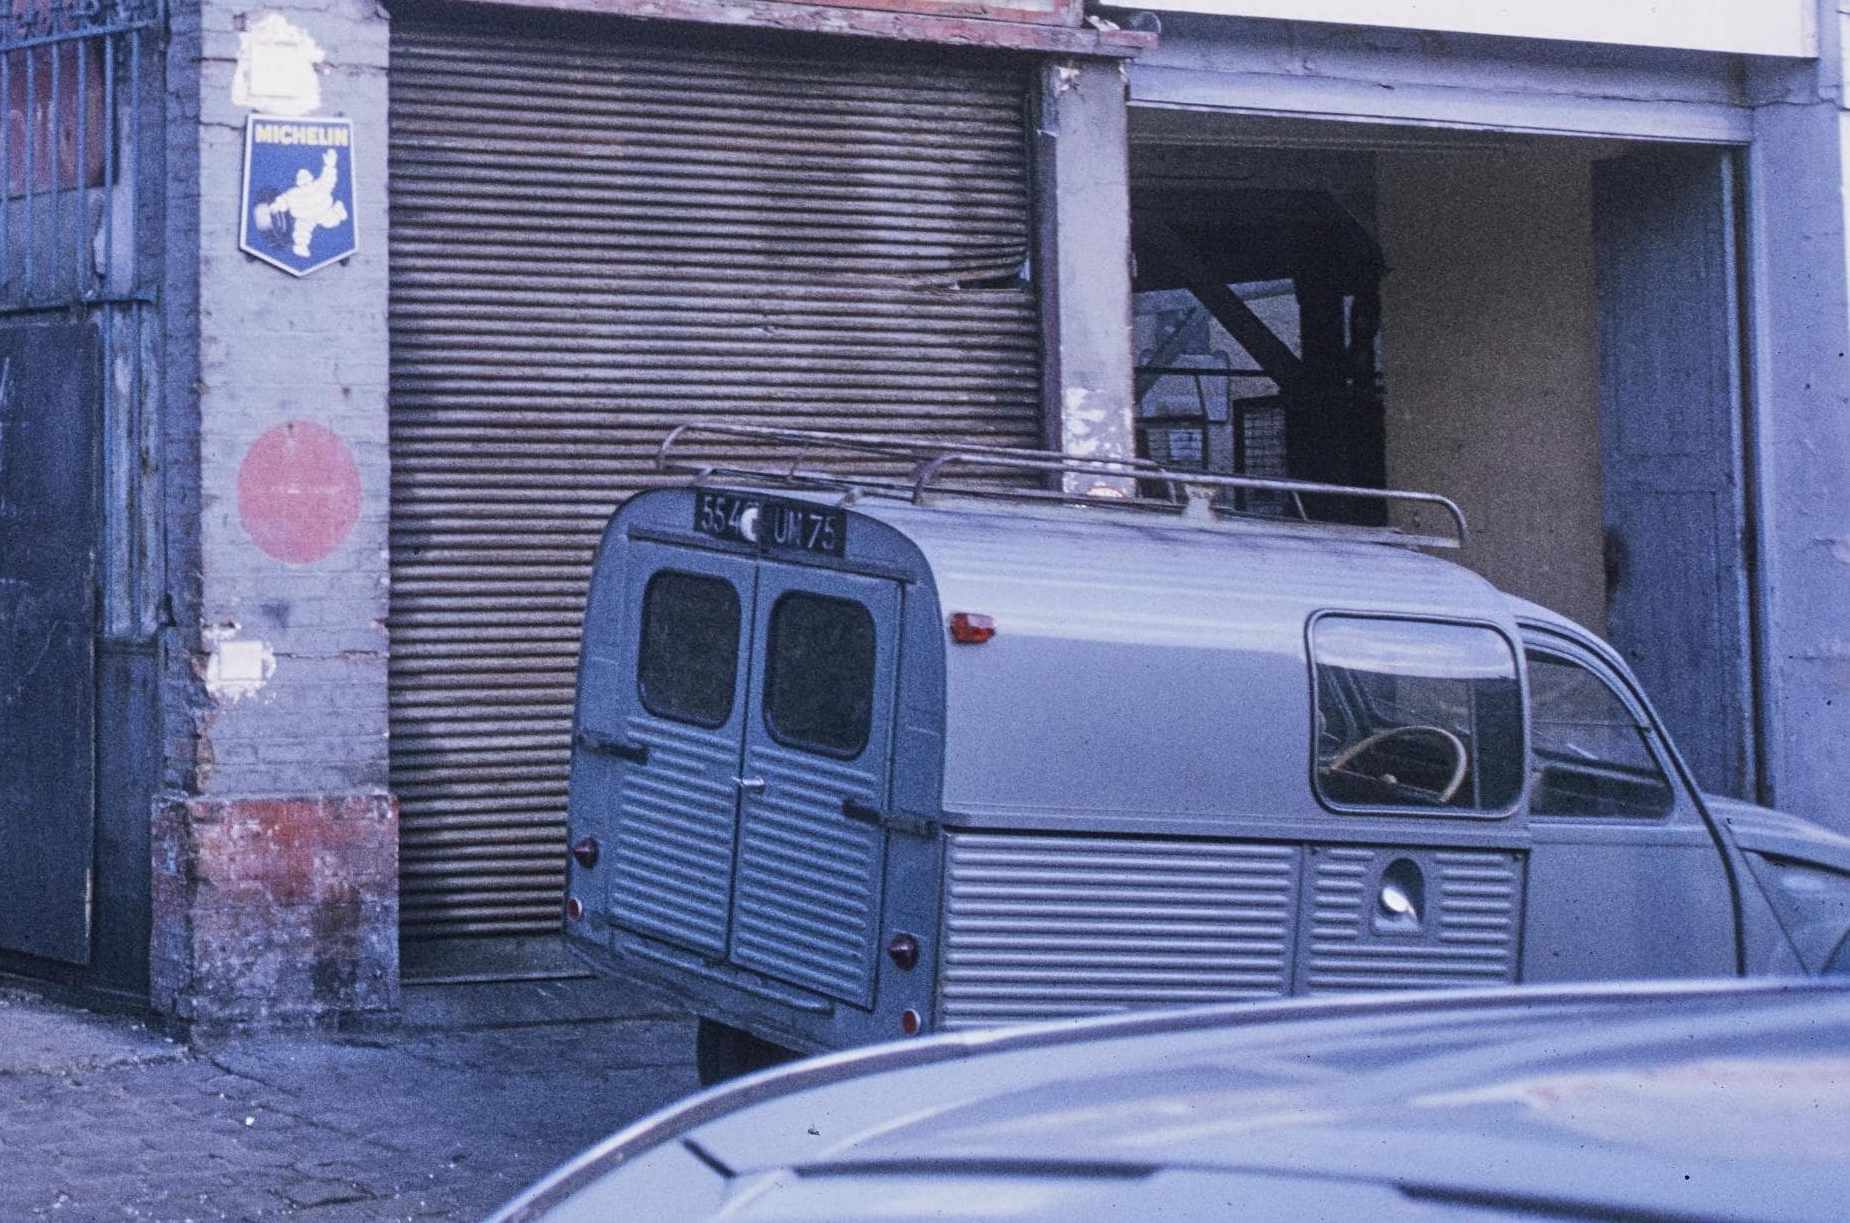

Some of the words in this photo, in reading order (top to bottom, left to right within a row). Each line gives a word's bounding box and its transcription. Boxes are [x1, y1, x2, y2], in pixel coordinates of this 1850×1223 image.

[254, 124, 349, 147] MICHELIN
[701, 495, 760, 534] 554
[806, 513, 837, 551] 75
